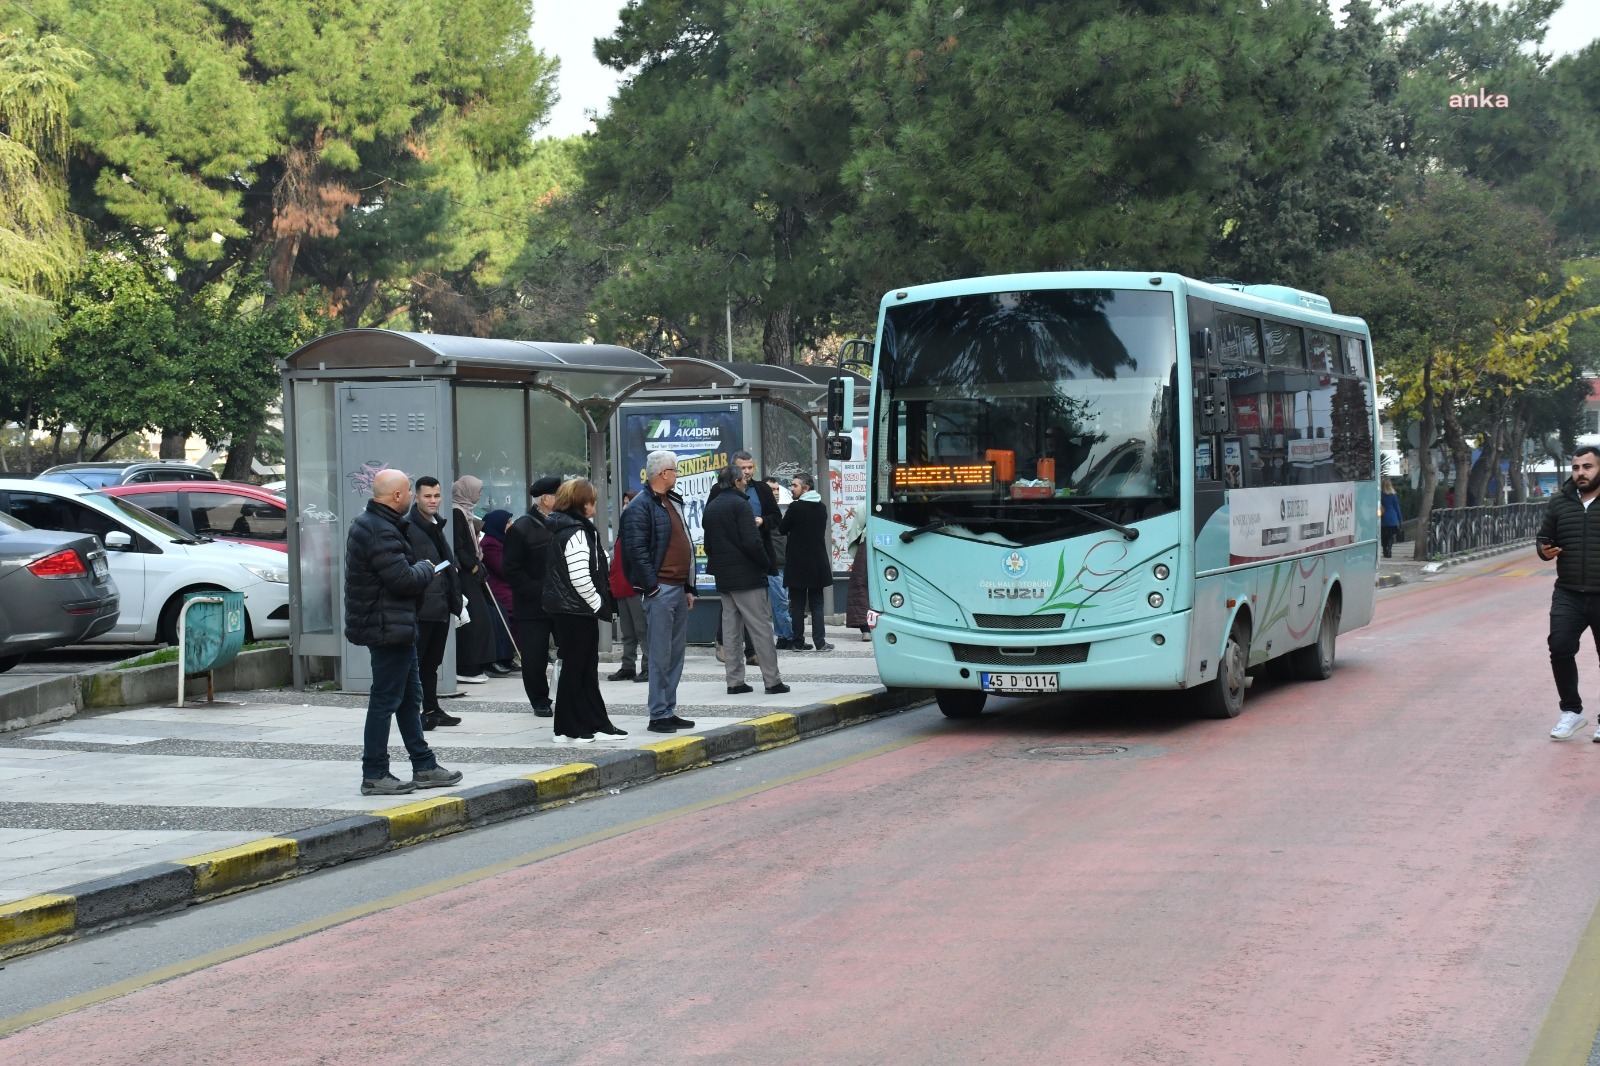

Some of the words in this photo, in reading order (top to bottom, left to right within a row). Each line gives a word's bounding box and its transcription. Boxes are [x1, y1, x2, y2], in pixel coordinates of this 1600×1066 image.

[679, 418, 698, 427] TAM
[677, 452, 729, 478] SINIFLAR
[979, 580, 996, 588] ÖZEL
[1017, 580, 1052, 588] OTOBÜSÜ
[989, 675, 1003, 687] 45
[1011, 675, 1018, 687] D
[1025, 675, 1056, 687] 0114
